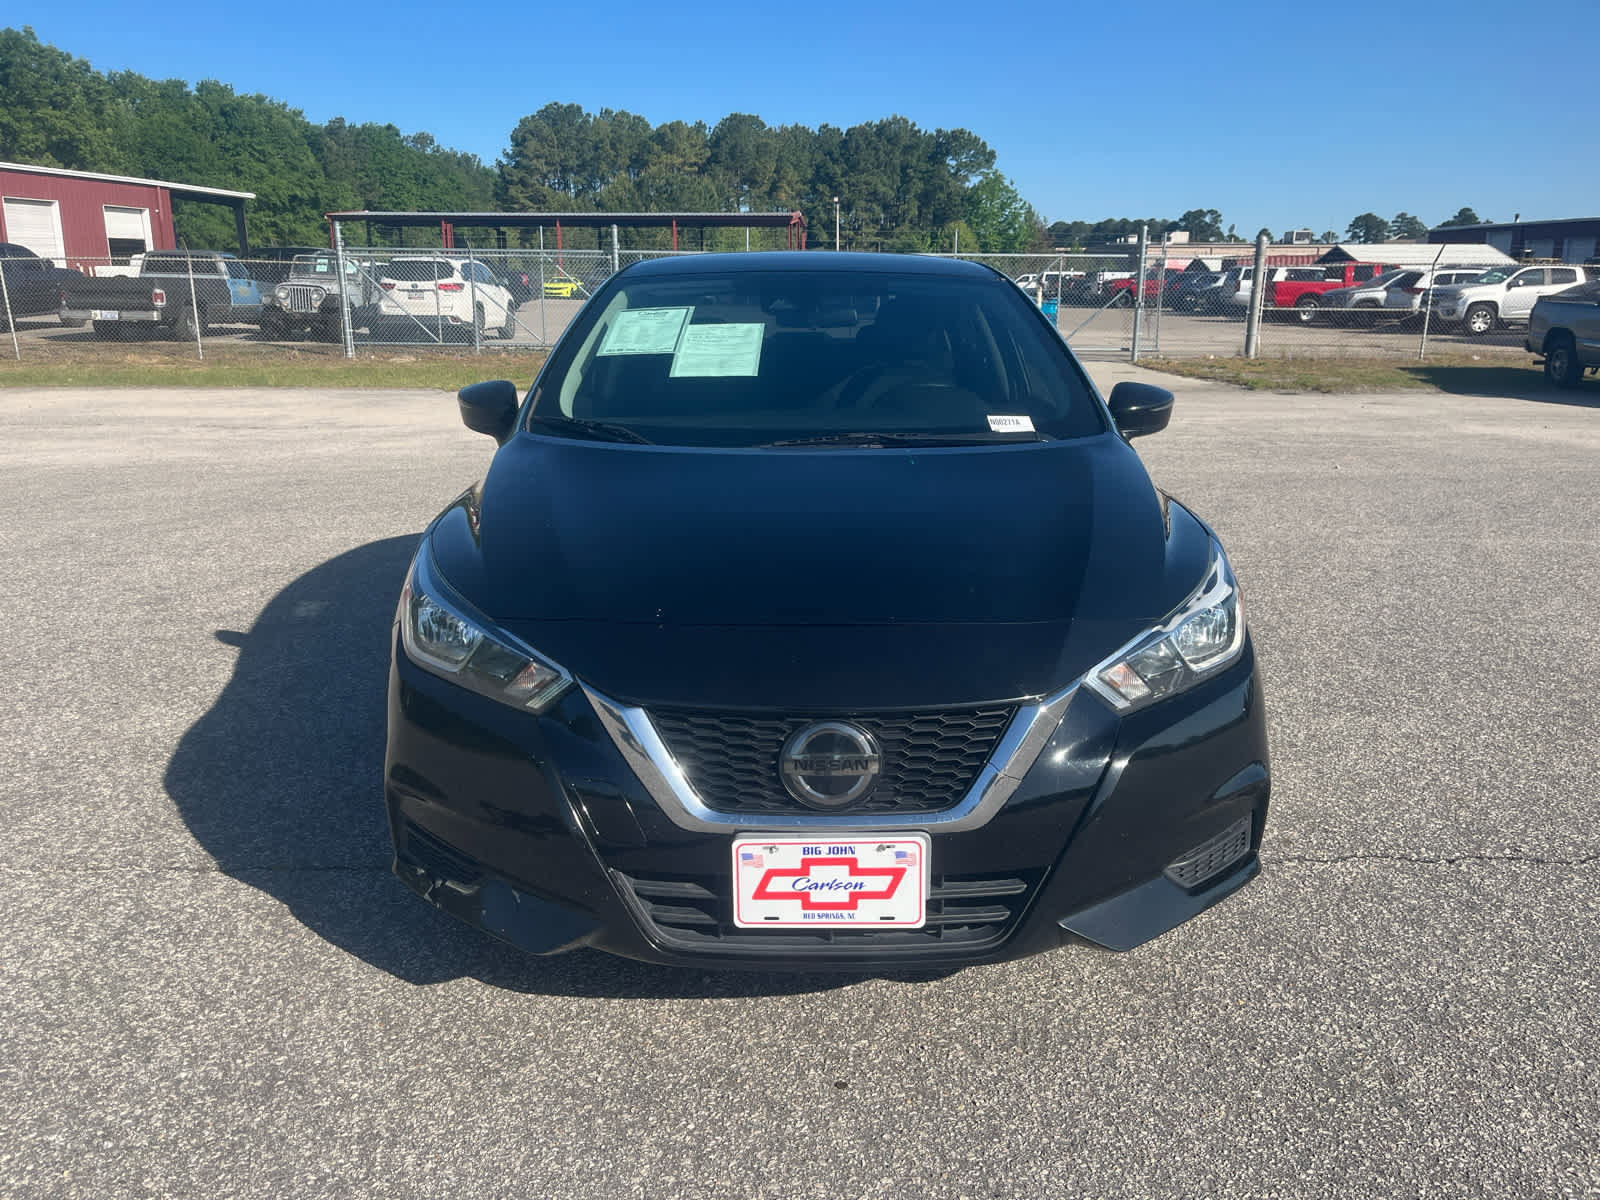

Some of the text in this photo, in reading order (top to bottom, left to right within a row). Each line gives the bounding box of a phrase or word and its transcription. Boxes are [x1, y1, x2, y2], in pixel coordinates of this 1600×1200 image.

[793, 759, 869, 771] NISSAN
[802, 846, 856, 856] BIG JOHN
[791, 876, 865, 891] Carlson
[803, 912, 816, 920] RED
[847, 912, 856, 920] NC
